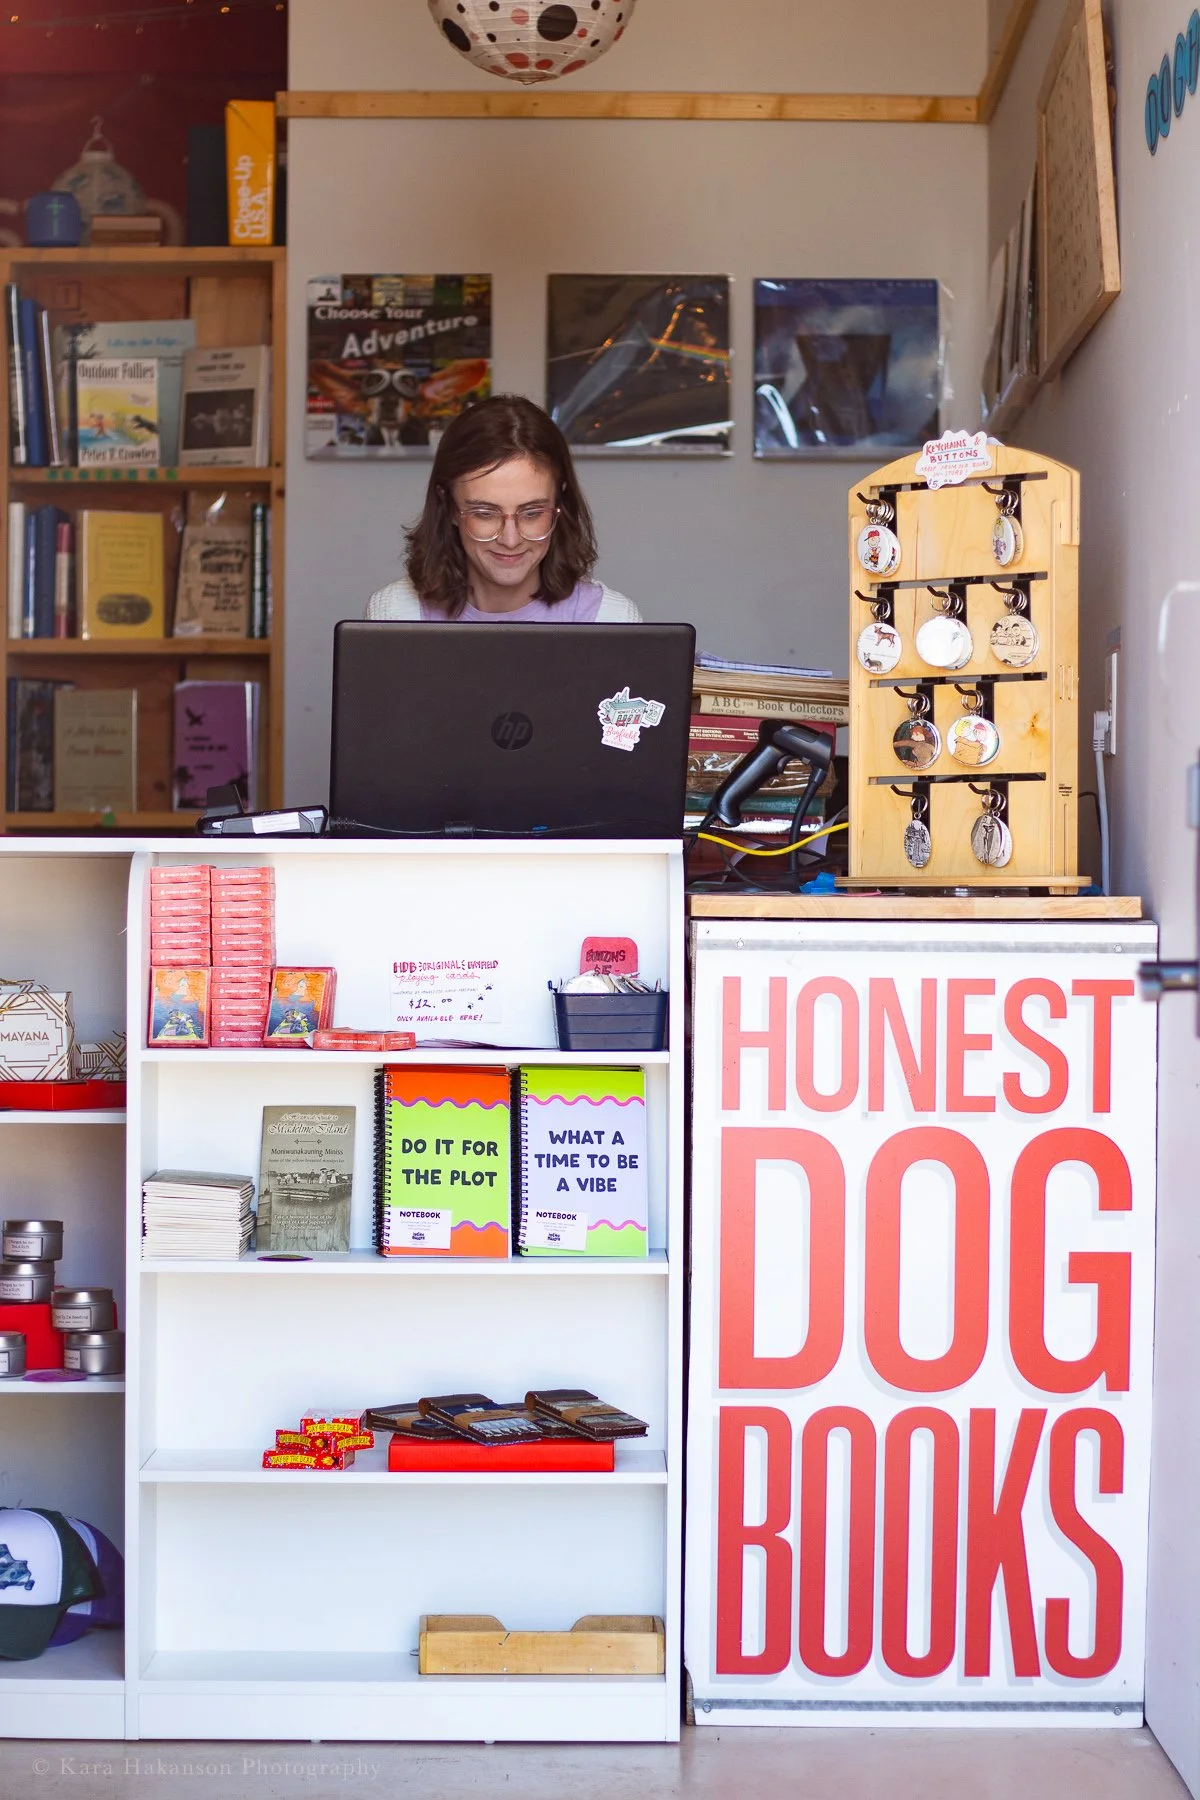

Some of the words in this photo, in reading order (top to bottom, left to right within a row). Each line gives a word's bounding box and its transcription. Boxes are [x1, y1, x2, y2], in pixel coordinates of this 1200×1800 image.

[234, 154, 254, 238] Close-Up
[315, 306, 380, 320] Choose
[385, 306, 424, 319] Your
[341, 314, 479, 359] Adventure
[78, 363, 120, 379] Outdoor
[122, 362, 155, 379] Follies
[925, 439, 967, 455] KEYCHAINS
[974, 436, 981, 446] &
[930, 449, 978, 463] BUTTONS
[757, 700, 784, 712] Book
[789, 702, 845, 716] Collectors
[496, 712, 530, 750] hp
[606, 726, 638, 743] Bayfield
[586, 949, 626, 962] BUTTONS
[393, 961, 417, 973] HDB
[422, 960, 461, 971] ORIGINAL
[467, 960, 499, 970] BAYFIELD
[395, 973, 439, 986] playing
[446, 970, 481, 979] cards
[459, 1014, 483, 1022] HERE!
[1, 1031, 50, 1042] MAYANA
[720, 975, 1135, 1114] HONEST
[268, 1122, 314, 1134] Madeline
[315, 1122, 349, 1134] Island
[548, 1130, 605, 1145] WHAT
[611, 1131, 625, 1145] A
[401, 1138, 427, 1154] DO
[435, 1139, 454, 1155] IT
[462, 1140, 499, 1156] FOR
[534, 1153, 580, 1168] TIME
[586, 1154, 610, 1168] TO
[617, 1154, 639, 1169] BE
[402, 1168, 442, 1185] THE
[450, 1169, 498, 1187] PLOT
[556, 1177, 570, 1192] A
[576, 1177, 617, 1193] VIBE
[399, 1210, 441, 1219] NOTEBOOK
[536, 1211, 577, 1221] NOTEBOOK
[718, 1125, 1133, 1394] DOG
[716, 1405, 1125, 1678] BOOKS
